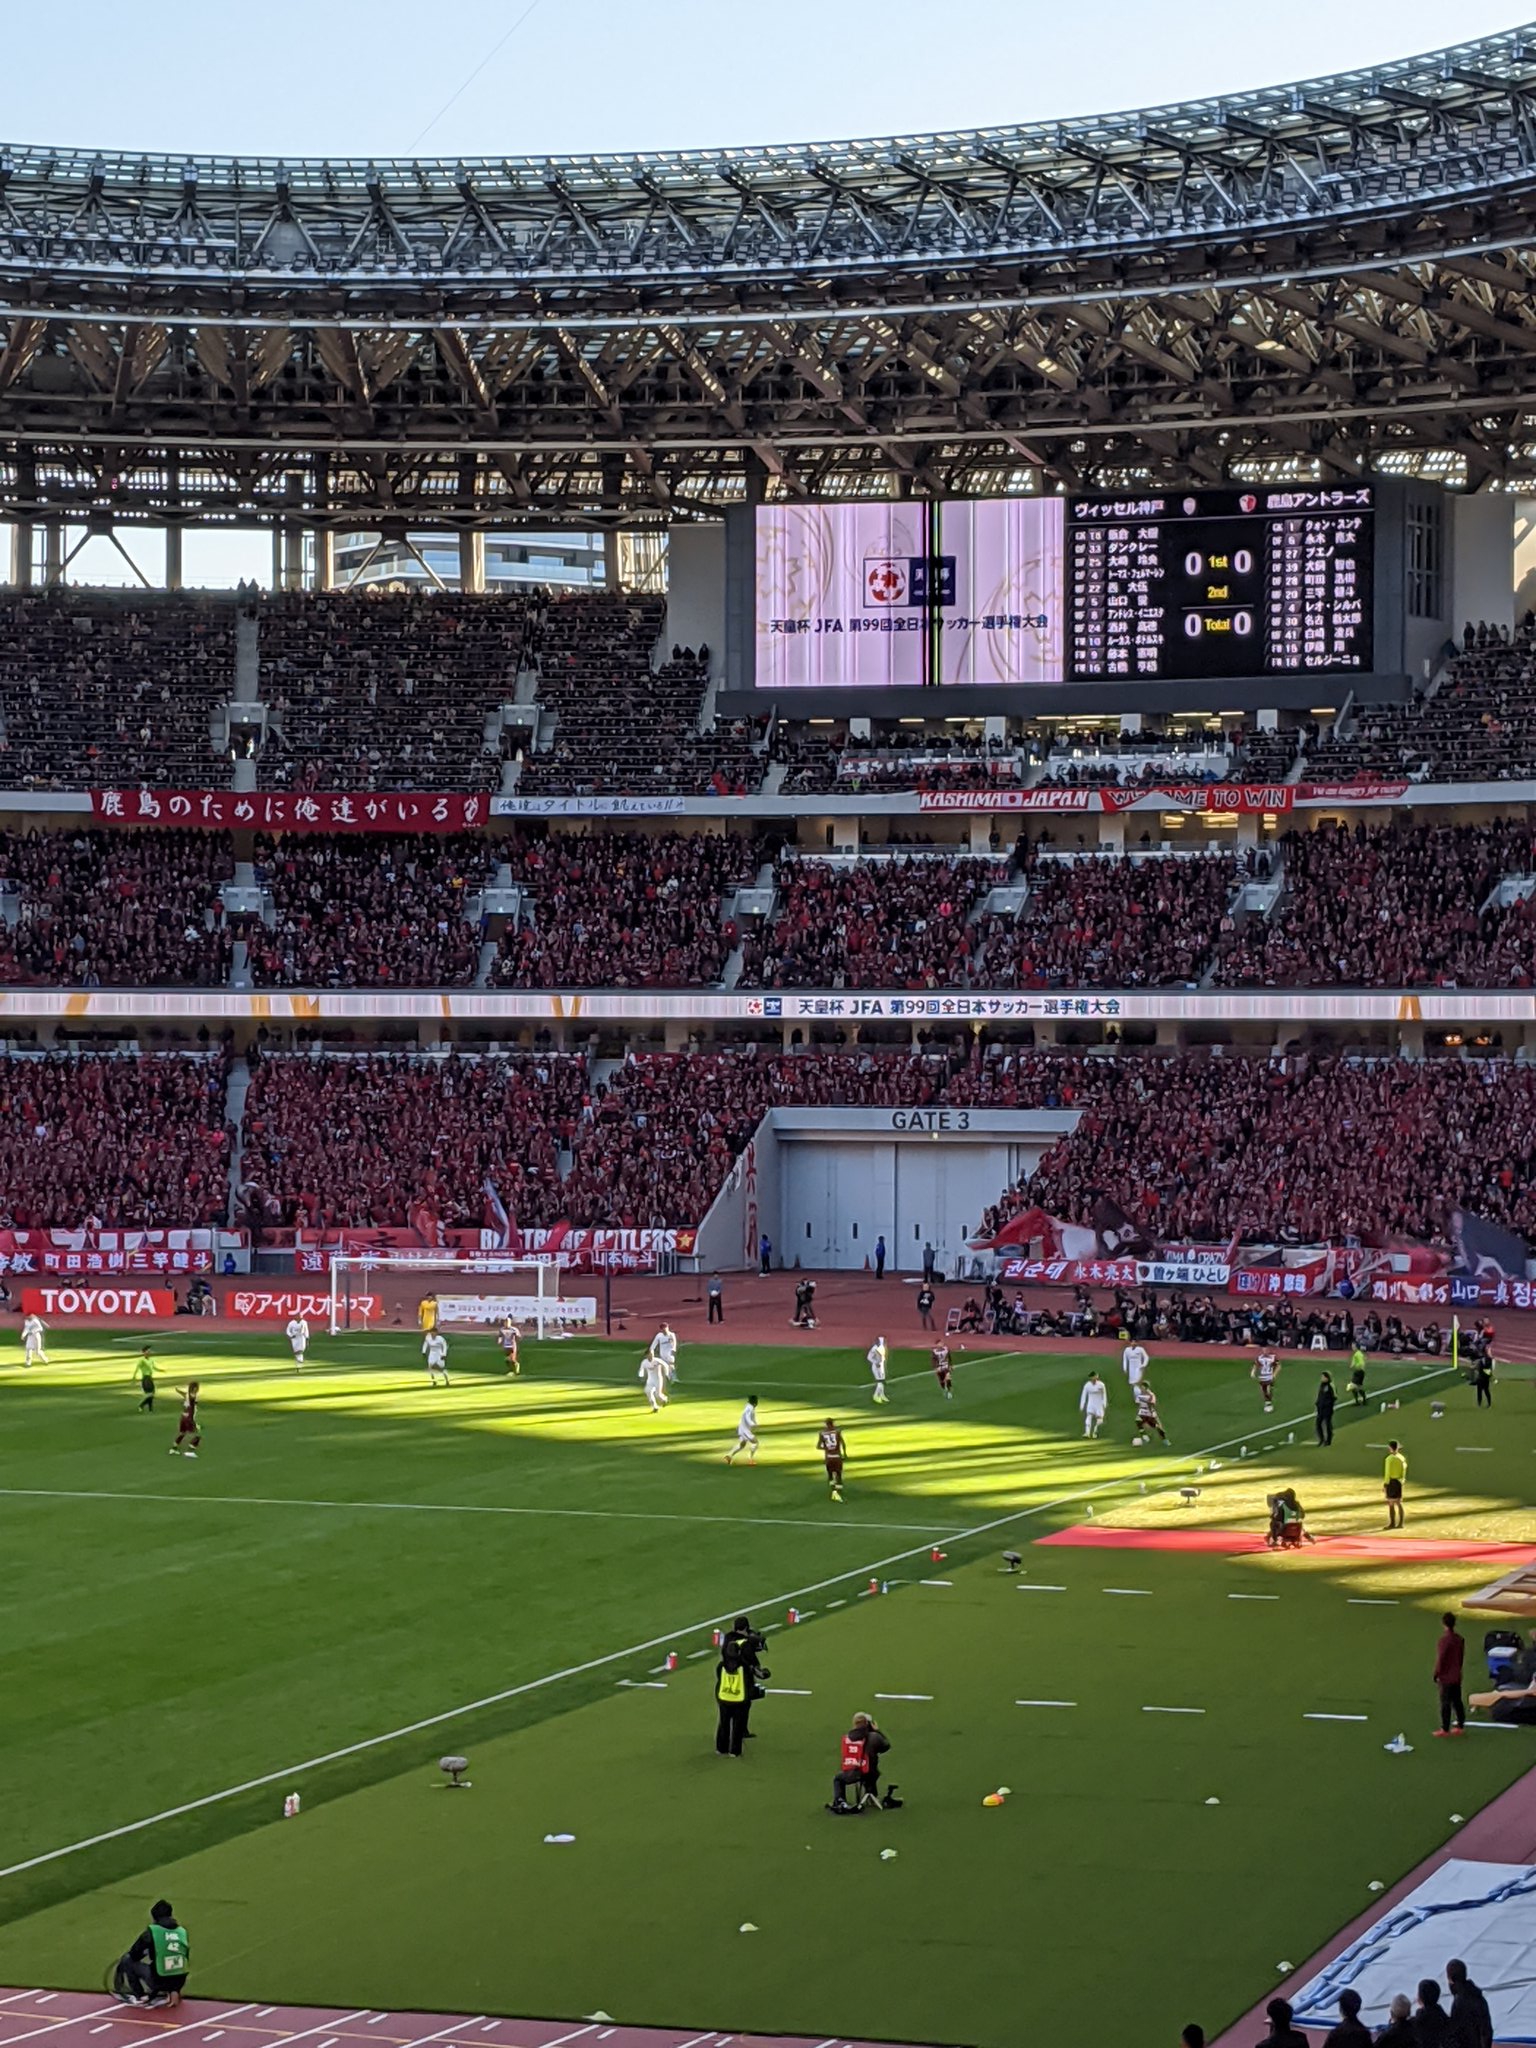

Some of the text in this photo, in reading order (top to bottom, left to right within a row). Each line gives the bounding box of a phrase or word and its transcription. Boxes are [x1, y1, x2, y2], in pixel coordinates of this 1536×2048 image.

[1267, 488, 1370, 509] 鹿島アントラーズ
[1185, 549, 1252, 576] 0 1st 0
[1207, 585, 1228, 599] 2nd
[770, 619, 811, 634] 天皇杯
[814, 619, 843, 634] JFA
[1184, 611, 1251, 637] 0 Total 0
[920, 790, 1089, 808] KASHIMA JAPAN
[1213, 788, 1241, 807] TO
[1244, 787, 1287, 808] WIN
[799, 999, 844, 1015] 天皇杯
[850, 999, 883, 1015] JFA
[890, 998, 1120, 1015] 第99回全日本サッカー選手権大会
[892, 1111, 970, 1130] GATE 3
[1004, 1259, 1068, 1280] 권순태
[40, 1289, 157, 1314] TOYOTA
[1512, 1281, 1536, 1308] 정
